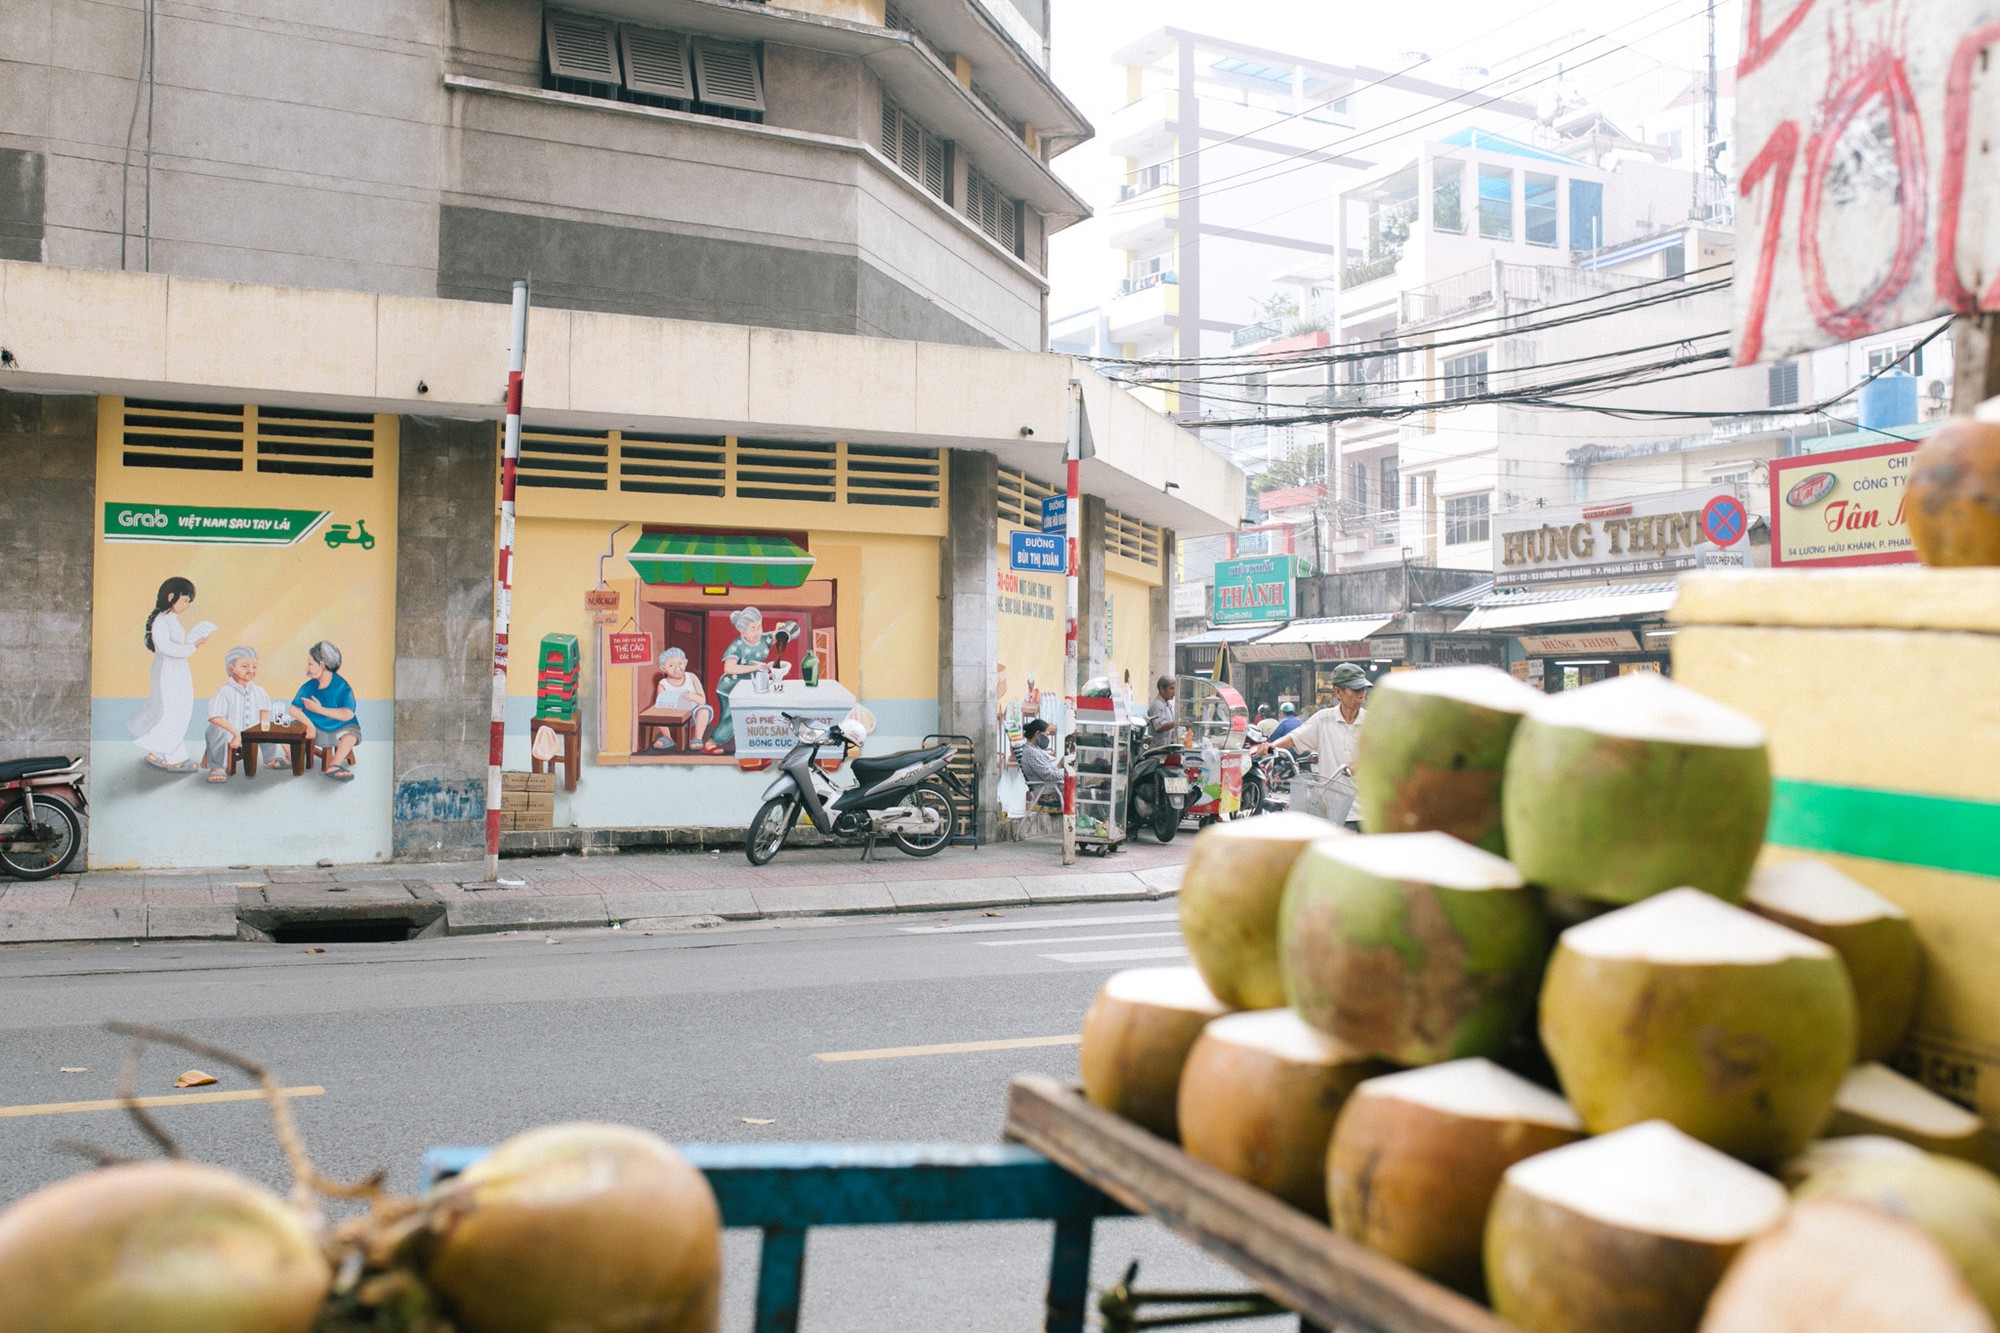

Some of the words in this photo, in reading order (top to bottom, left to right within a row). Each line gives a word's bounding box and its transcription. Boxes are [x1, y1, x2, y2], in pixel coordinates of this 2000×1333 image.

[1888, 457, 1908, 469] CHI
[1853, 477, 1888, 491] CÔNG
[1893, 475, 1907, 487] TY
[118, 509, 168, 528] Grab
[178, 514, 202, 529] VIỆT
[203, 517, 228, 528] NAM
[229, 517, 251, 529] SAU
[252, 519, 272, 530] TAY
[1824, 500, 1881, 533] Tân
[1025, 537, 1055, 549] ĐƯỜNG
[1501, 523, 1595, 565] HƯNG
[1789, 548, 1797, 556] 54
[1799, 546, 1826, 556] LƯƠNG
[1828, 542, 1845, 553] HỮU
[1017, 549, 1029, 564] BÙI
[1030, 552, 1041, 568] THỊ
[1042, 551, 1059, 567] XUÂN
[1218, 575, 1285, 609] THÀNH
[1578, 637, 1619, 650] THỊNH
